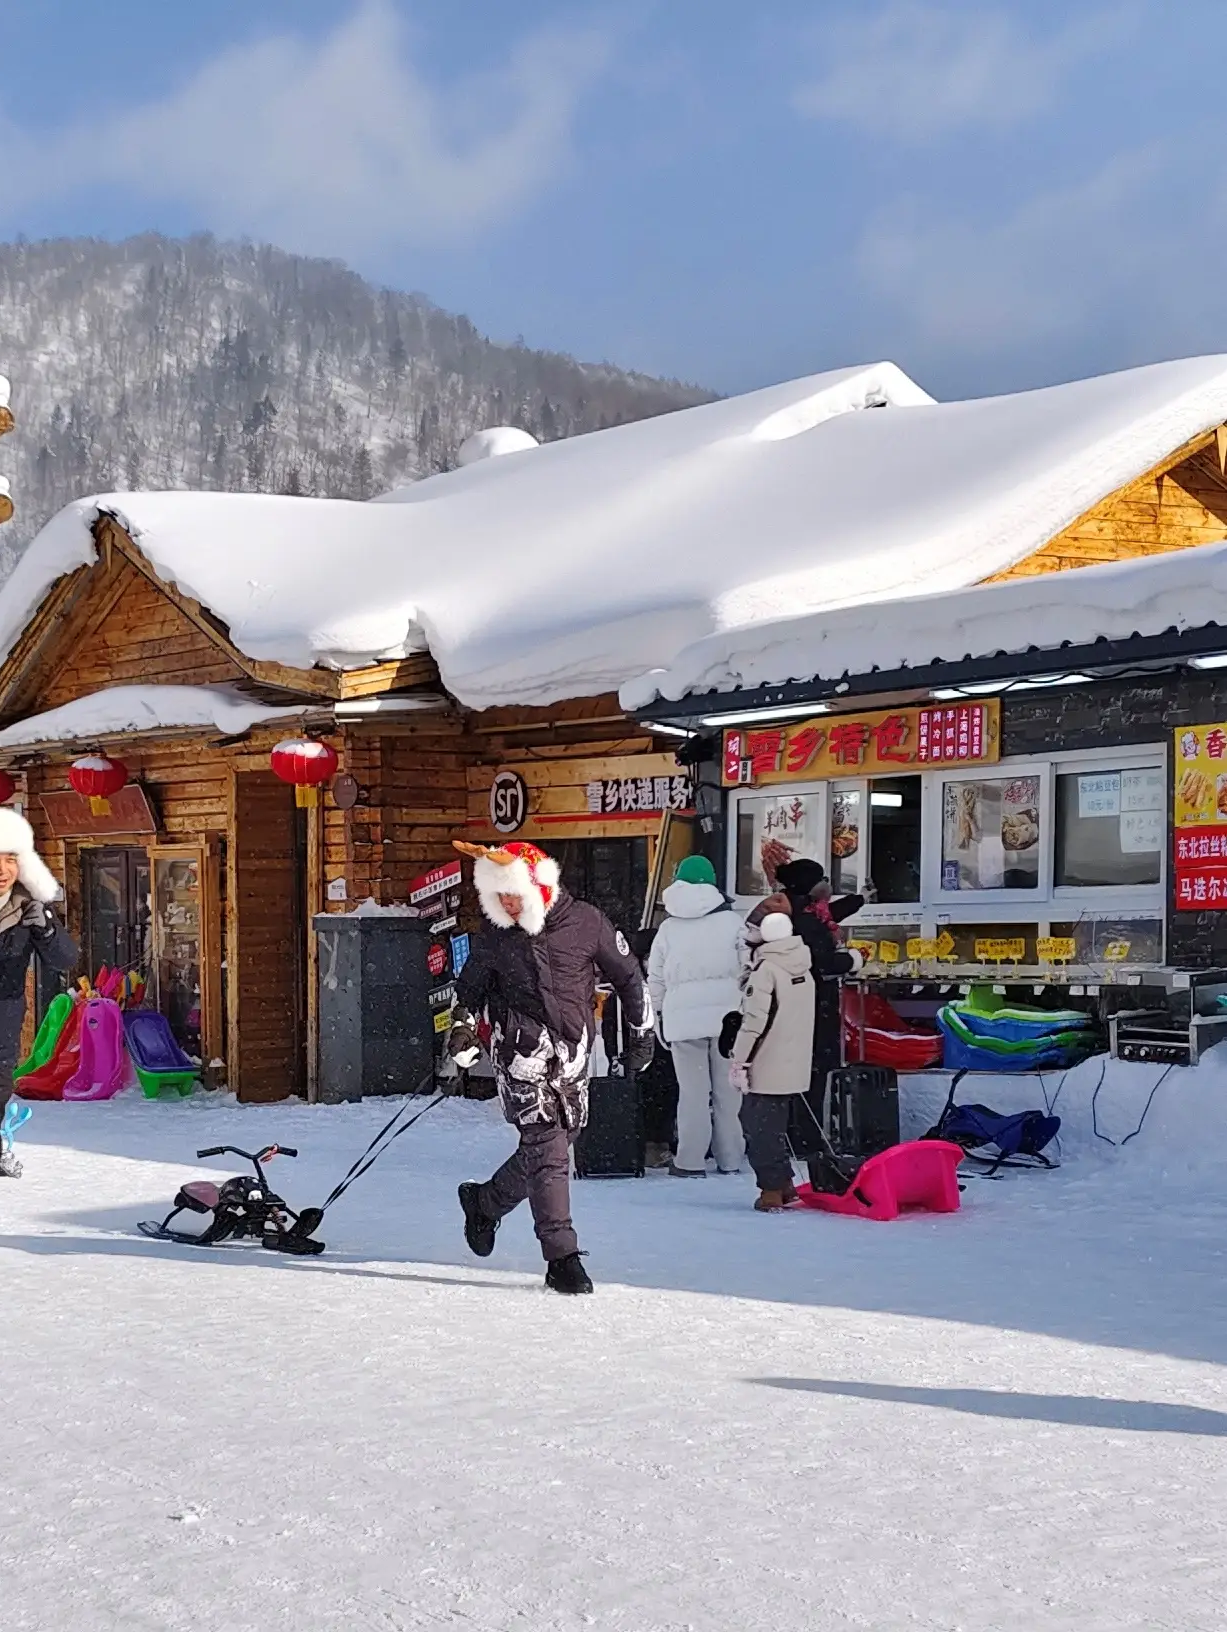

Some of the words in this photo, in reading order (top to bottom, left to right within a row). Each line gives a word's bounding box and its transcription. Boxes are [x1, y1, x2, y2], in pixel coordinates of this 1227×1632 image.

[747, 714, 915, 774] 雪乡特色
[932, 711, 942, 757] 烤冷面
[945, 710, 954, 756] 手抓饼
[587, 776, 693, 813] 雪乡快递服务
[763, 797, 804, 835] 羊肉串
